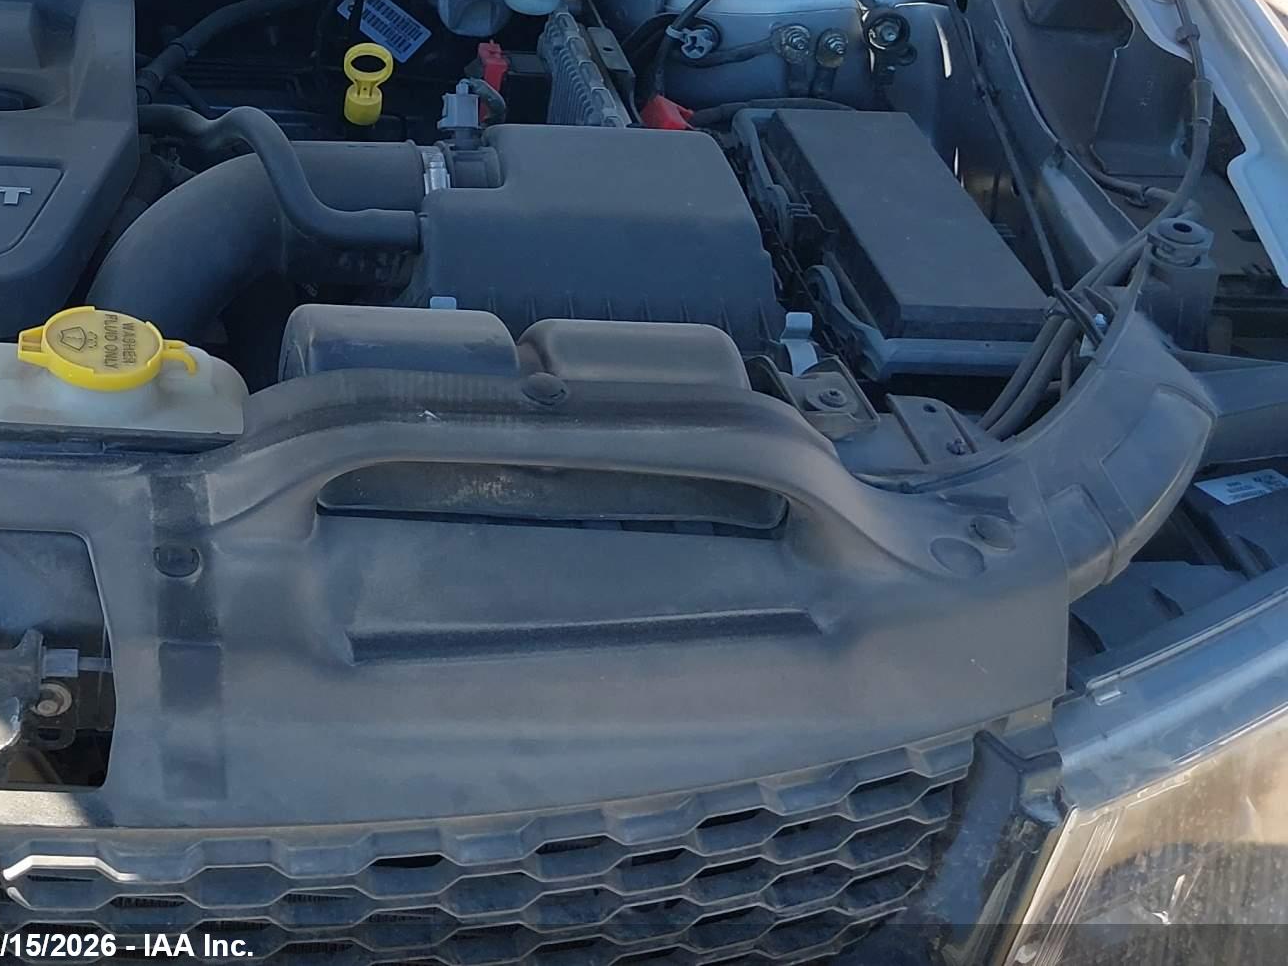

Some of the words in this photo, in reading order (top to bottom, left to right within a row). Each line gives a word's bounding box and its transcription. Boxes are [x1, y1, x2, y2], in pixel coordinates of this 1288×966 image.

[104, 314, 118, 342] FLUID
[104, 345, 119, 369] ONLY
[123, 323, 137, 364] WASHER
